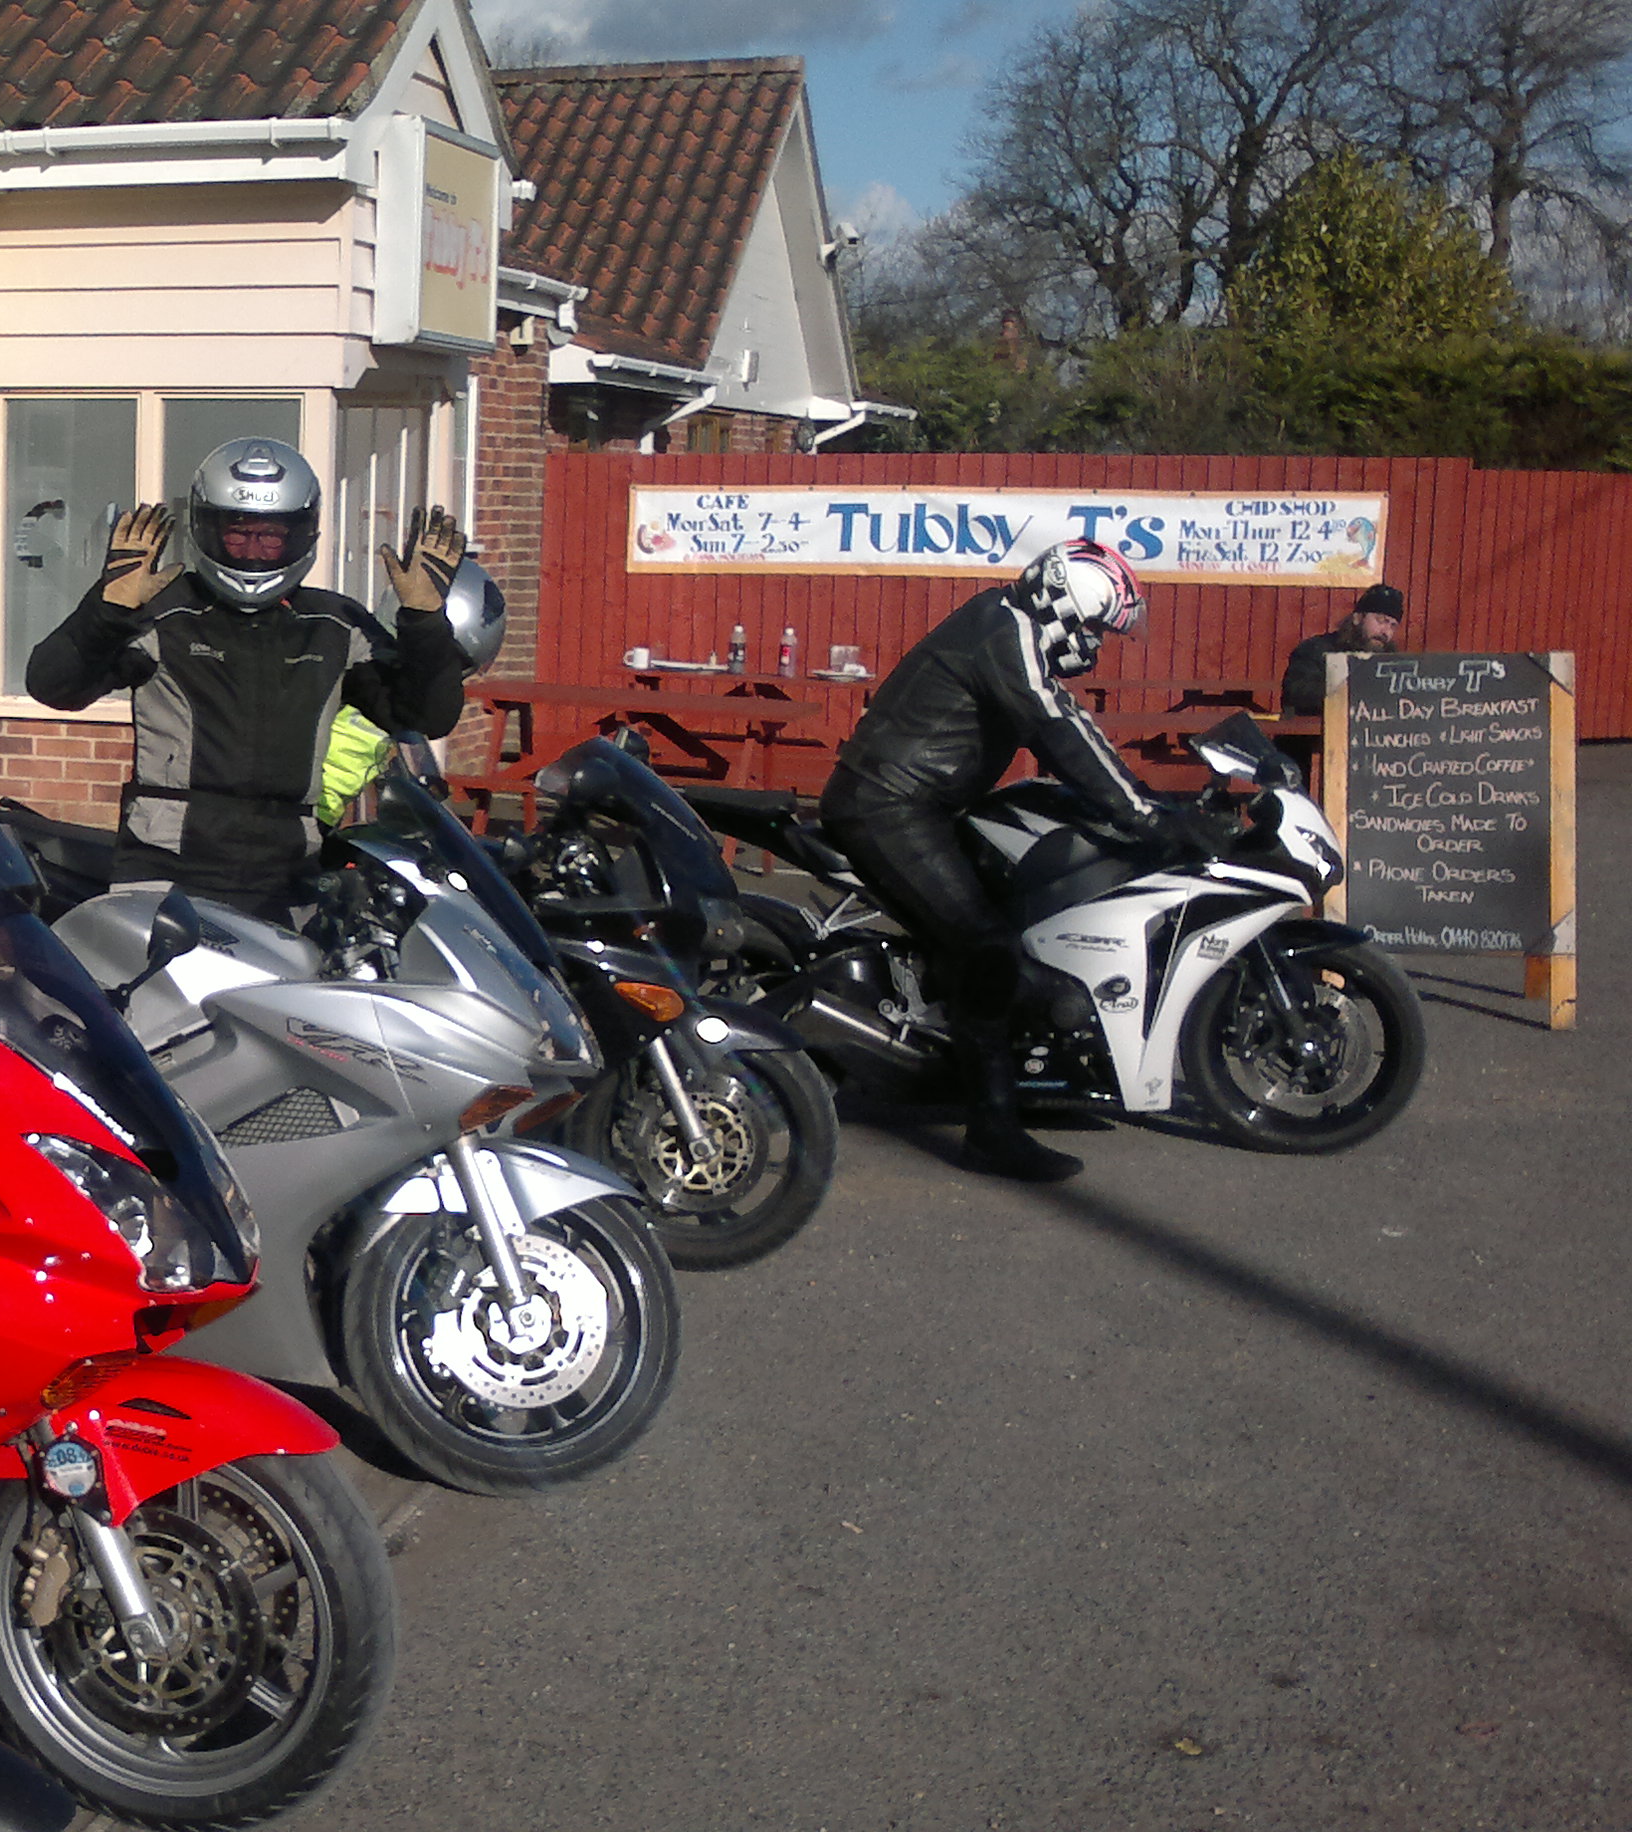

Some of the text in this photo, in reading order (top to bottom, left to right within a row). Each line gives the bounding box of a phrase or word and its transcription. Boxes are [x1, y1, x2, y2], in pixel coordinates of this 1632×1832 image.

[696, 494, 750, 510] CAFE
[1225, 501, 1336, 516] CHIP SHOP
[690, 534, 726, 553] Sun
[826, 503, 1166, 563] Tubby T's
[1354, 697, 1539, 722] ALL DAY BREAKFAST
[1364, 727, 1431, 748] LUNCHES
[1488, 721, 1543, 744] SNACKS
[1475, 751, 1528, 775] COFFEE
[1383, 784, 1423, 811] ICE
[1426, 782, 1473, 807] COLD
[1355, 809, 1528, 832] SANDWICHES MADE TO
[1417, 834, 1483, 853] ORDER
[1369, 858, 1516, 883] PHONE ORDERS
[1415, 885, 1475, 904] TAKEN
